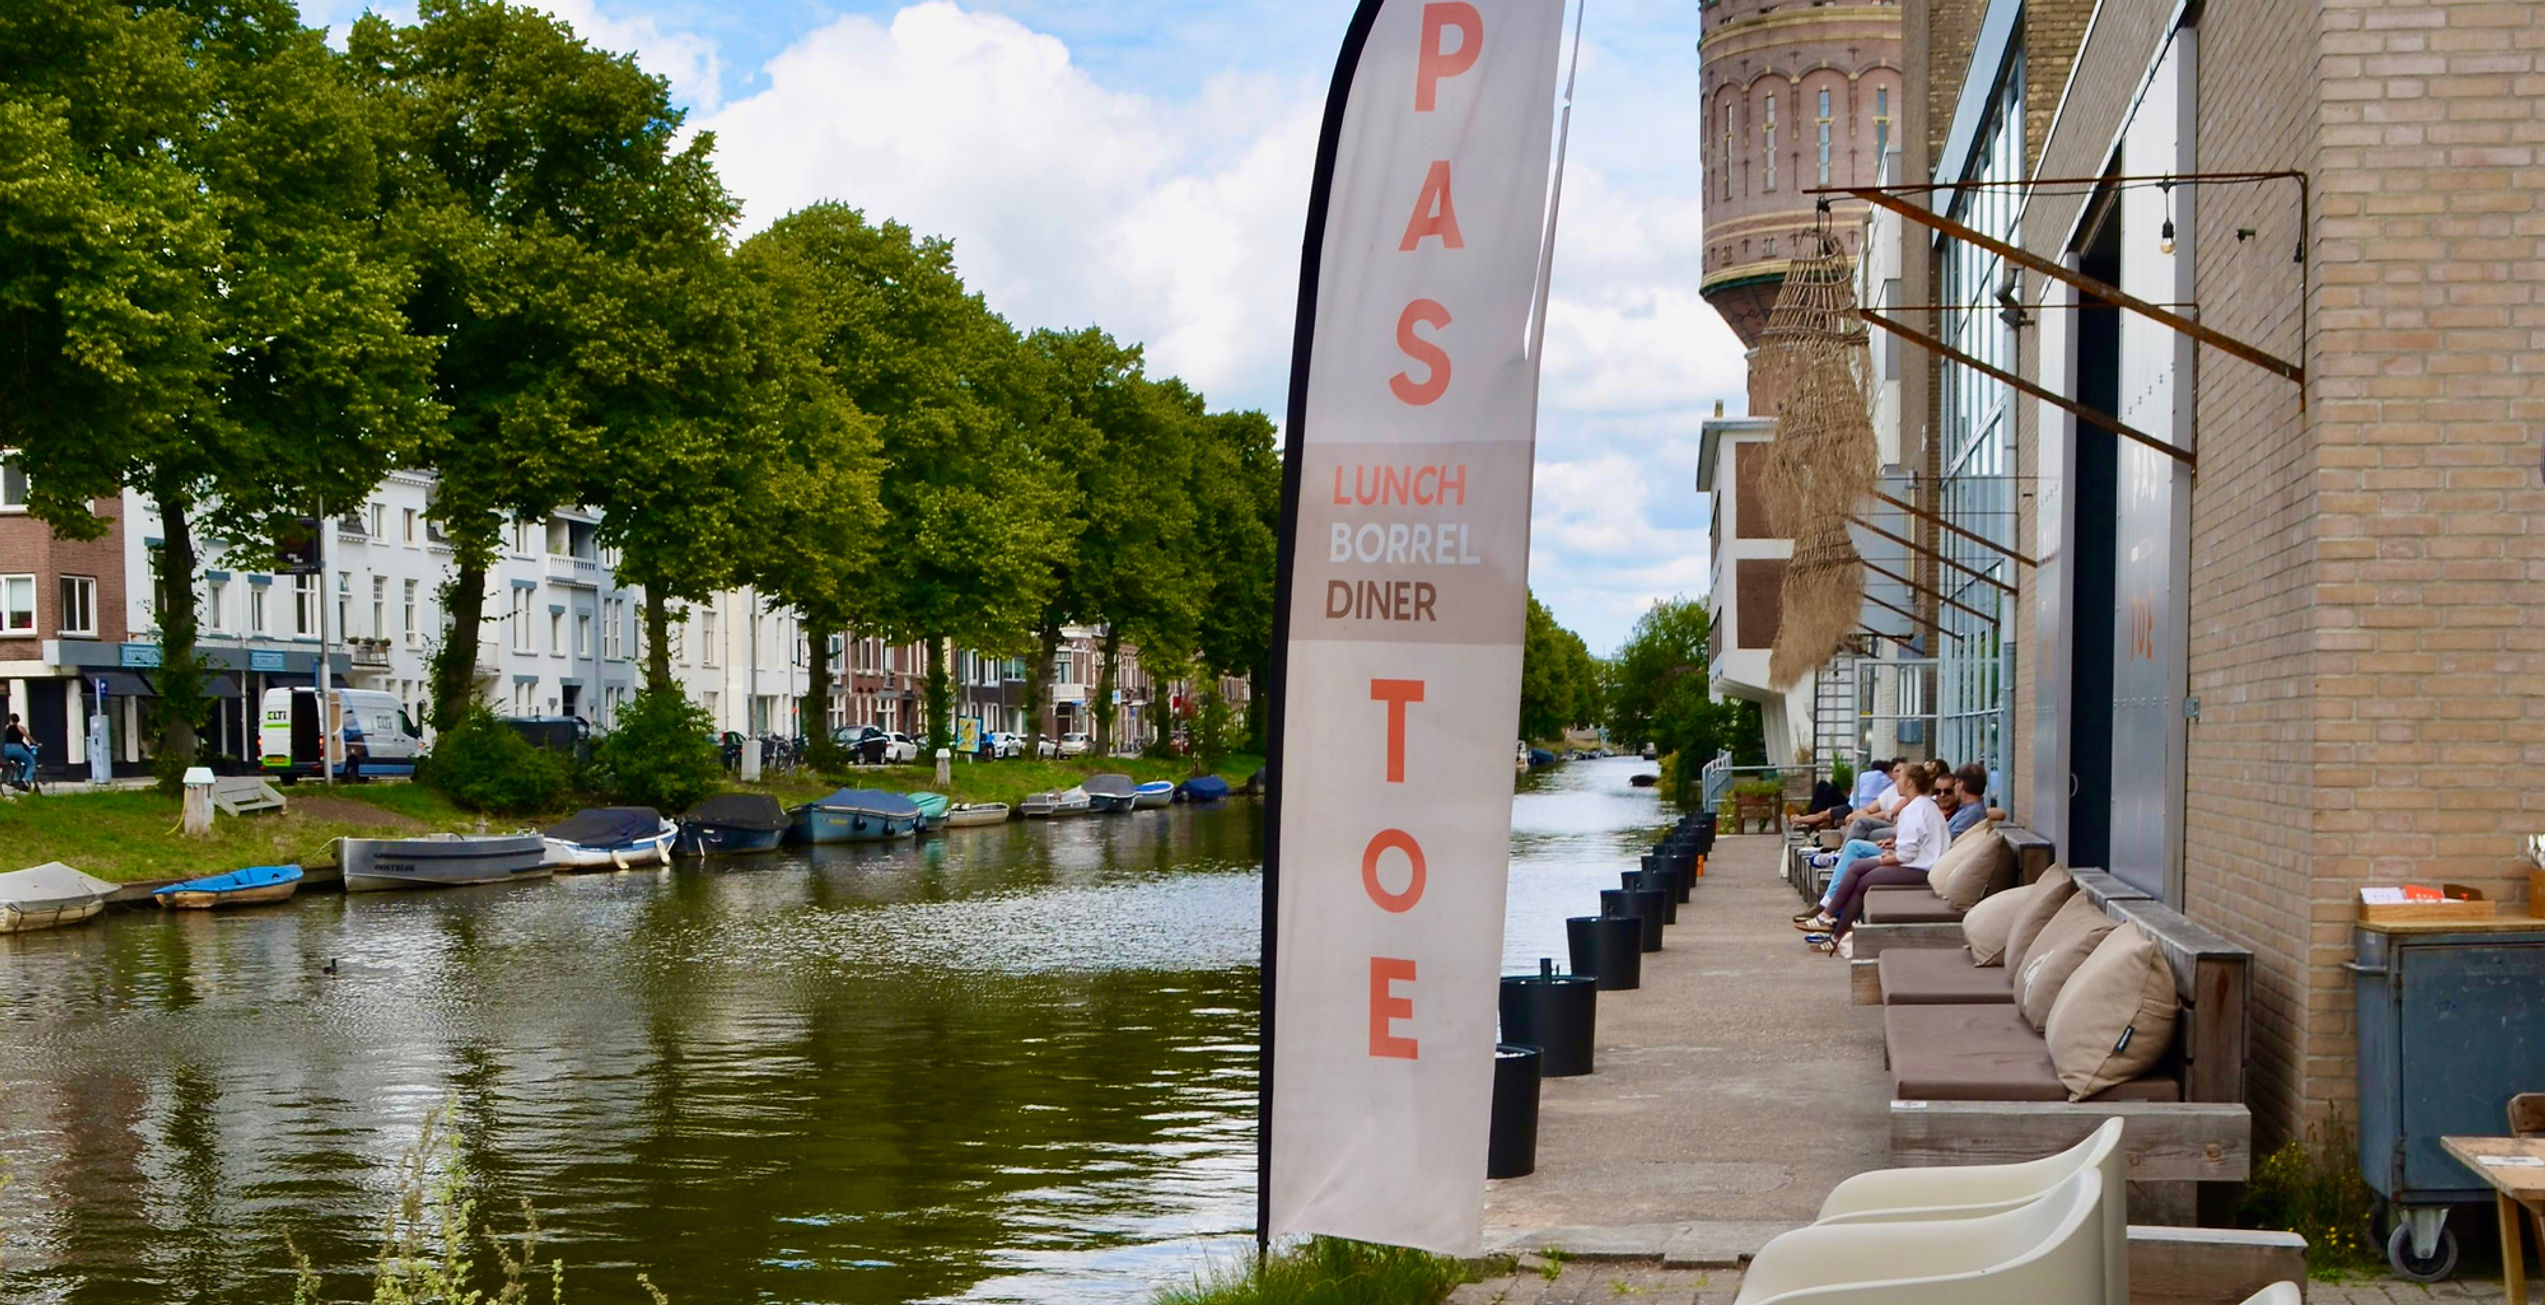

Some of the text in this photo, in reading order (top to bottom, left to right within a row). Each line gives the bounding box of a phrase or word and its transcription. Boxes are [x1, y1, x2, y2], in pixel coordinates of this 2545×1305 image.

[1390, 2, 1483, 405] PAS
[1334, 465, 1465, 506] LUNCH
[1330, 522, 1481, 565] BORREL
[1326, 580, 1437, 622] DINER
[2131, 592, 2153, 661] TOE
[1362, 678, 1426, 1060] TOE
